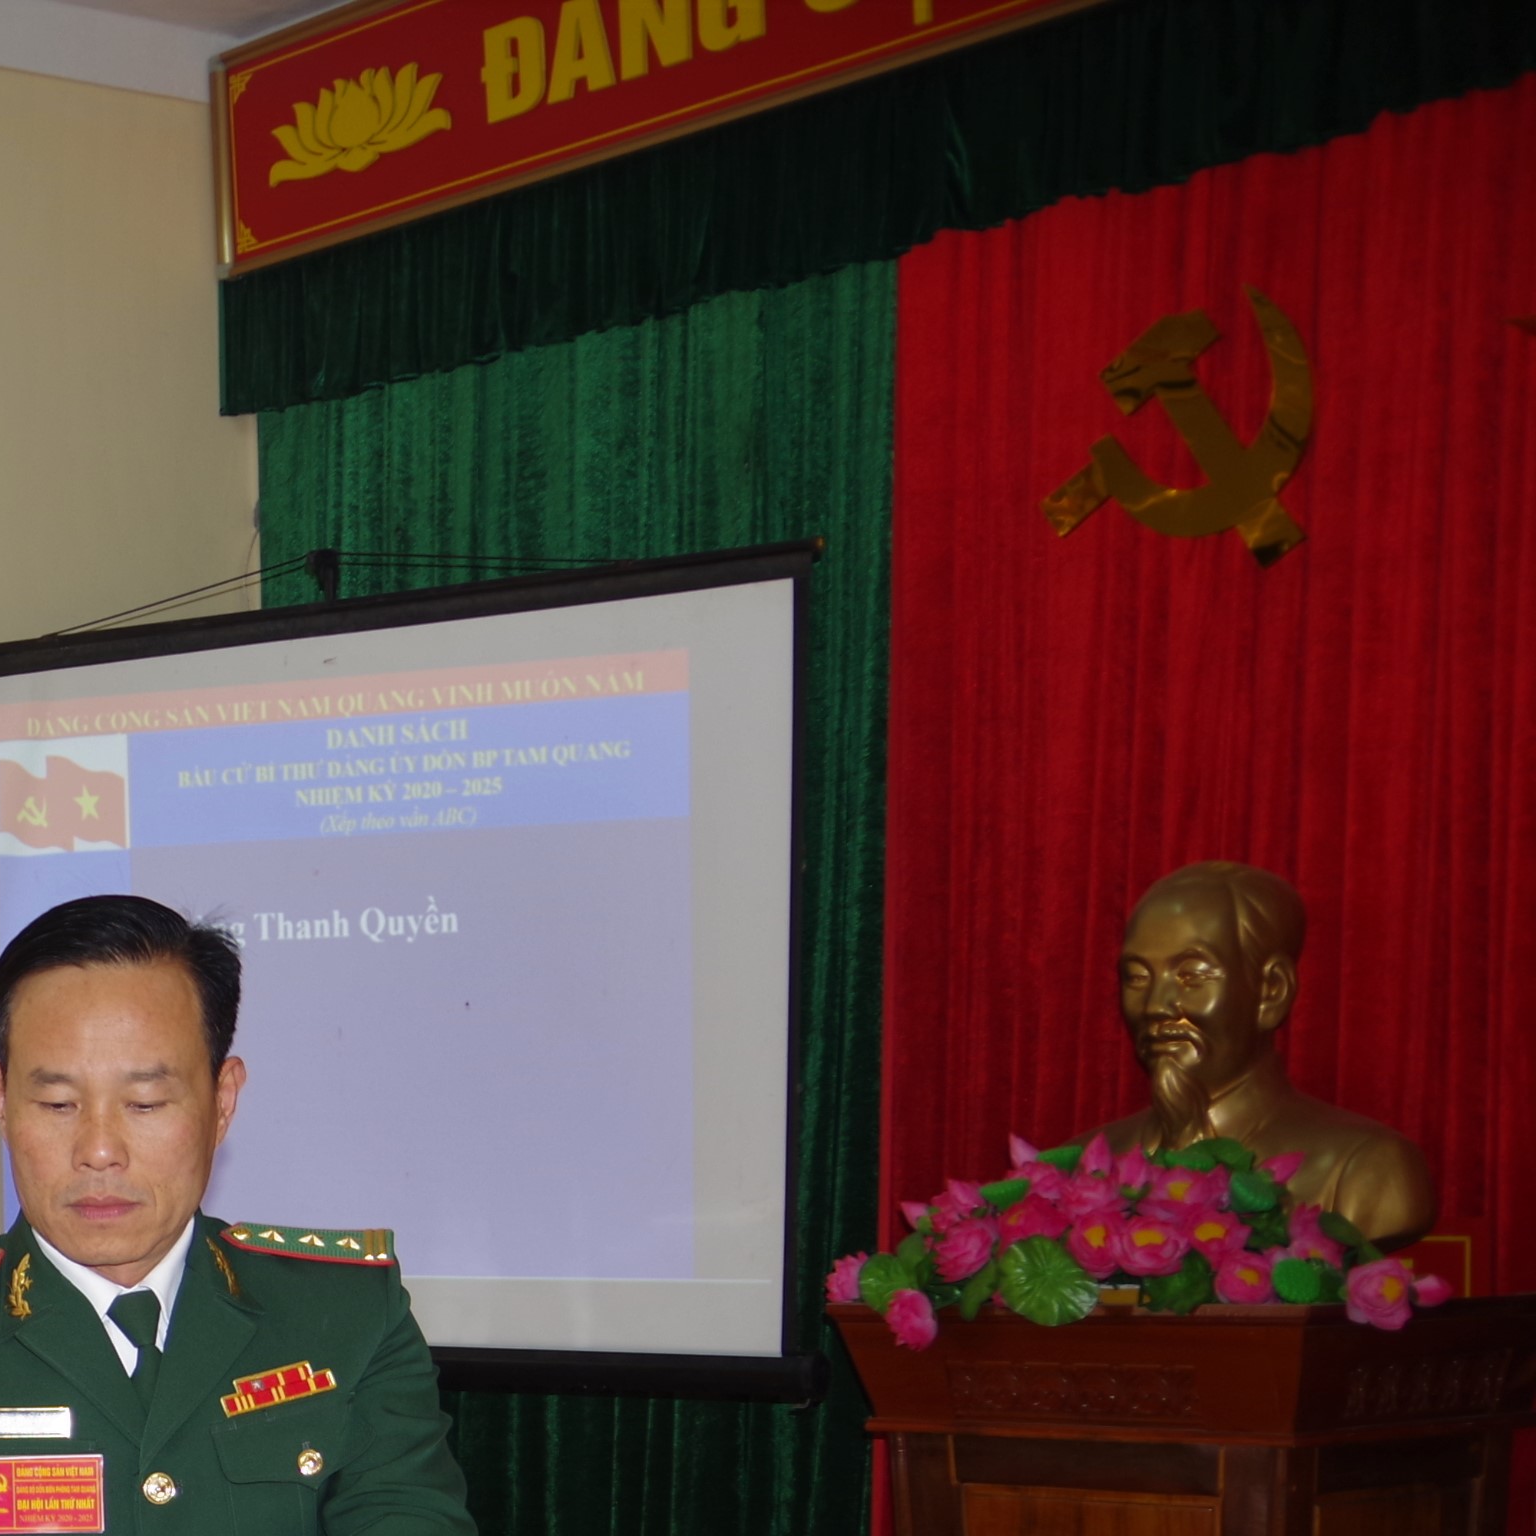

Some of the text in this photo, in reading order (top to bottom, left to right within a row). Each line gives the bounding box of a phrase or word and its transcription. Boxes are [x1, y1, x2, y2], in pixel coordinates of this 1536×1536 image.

[278, 695, 330, 718] NAM
[337, 689, 425, 717] QUANG
[431, 682, 494, 705] VINH
[326, 715, 469, 749] DANH SÁCH
[472, 747, 500, 769] BP
[503, 745, 549, 767] TAM
[552, 740, 632, 767] QUANG
[402, 780, 443, 800] 2020
[461, 776, 504, 797] 2025
[361, 810, 396, 831] theo
[253, 909, 350, 942] Thanh
[359, 895, 459, 944] Quyền
[79, 1467, 94, 1477] NAM
